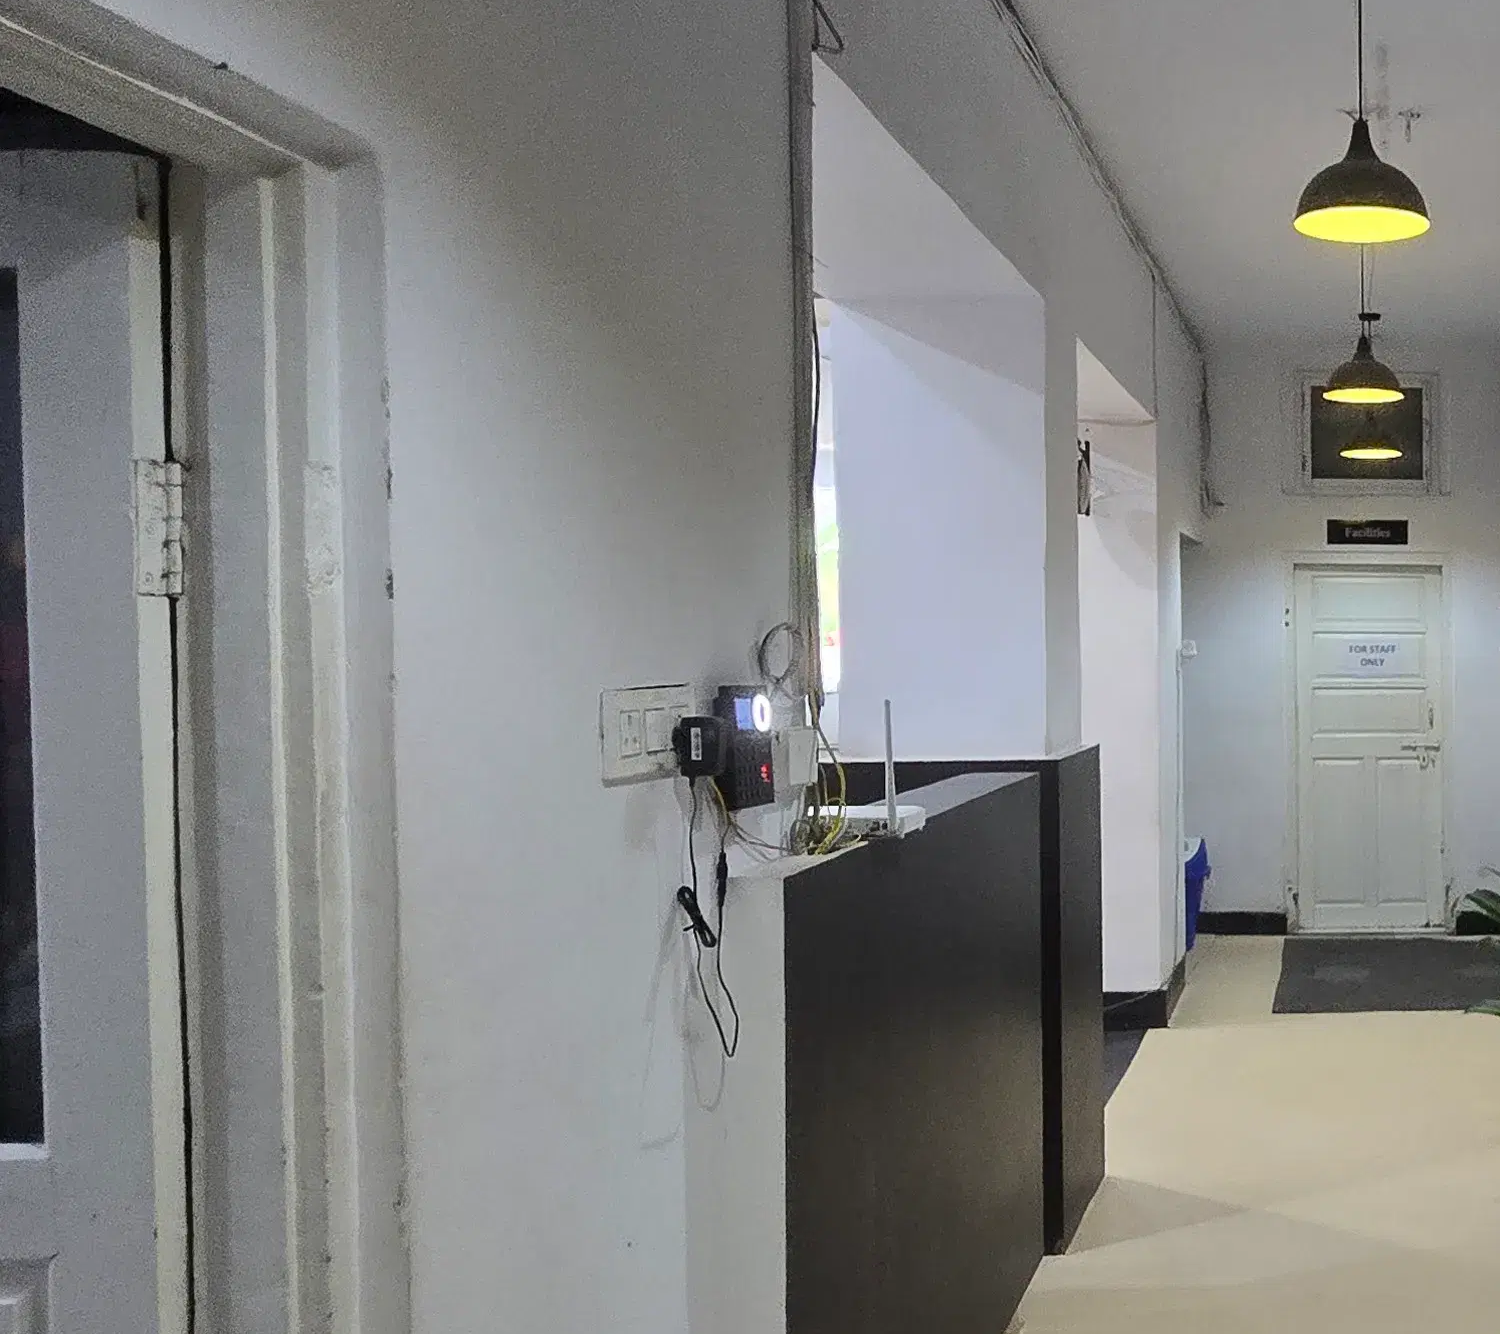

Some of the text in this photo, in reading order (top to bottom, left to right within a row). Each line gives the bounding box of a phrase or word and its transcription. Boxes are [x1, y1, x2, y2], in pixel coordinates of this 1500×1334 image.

[1349, 645, 1396, 653] FOR STAFF
[1360, 658, 1385, 666] ONLY
